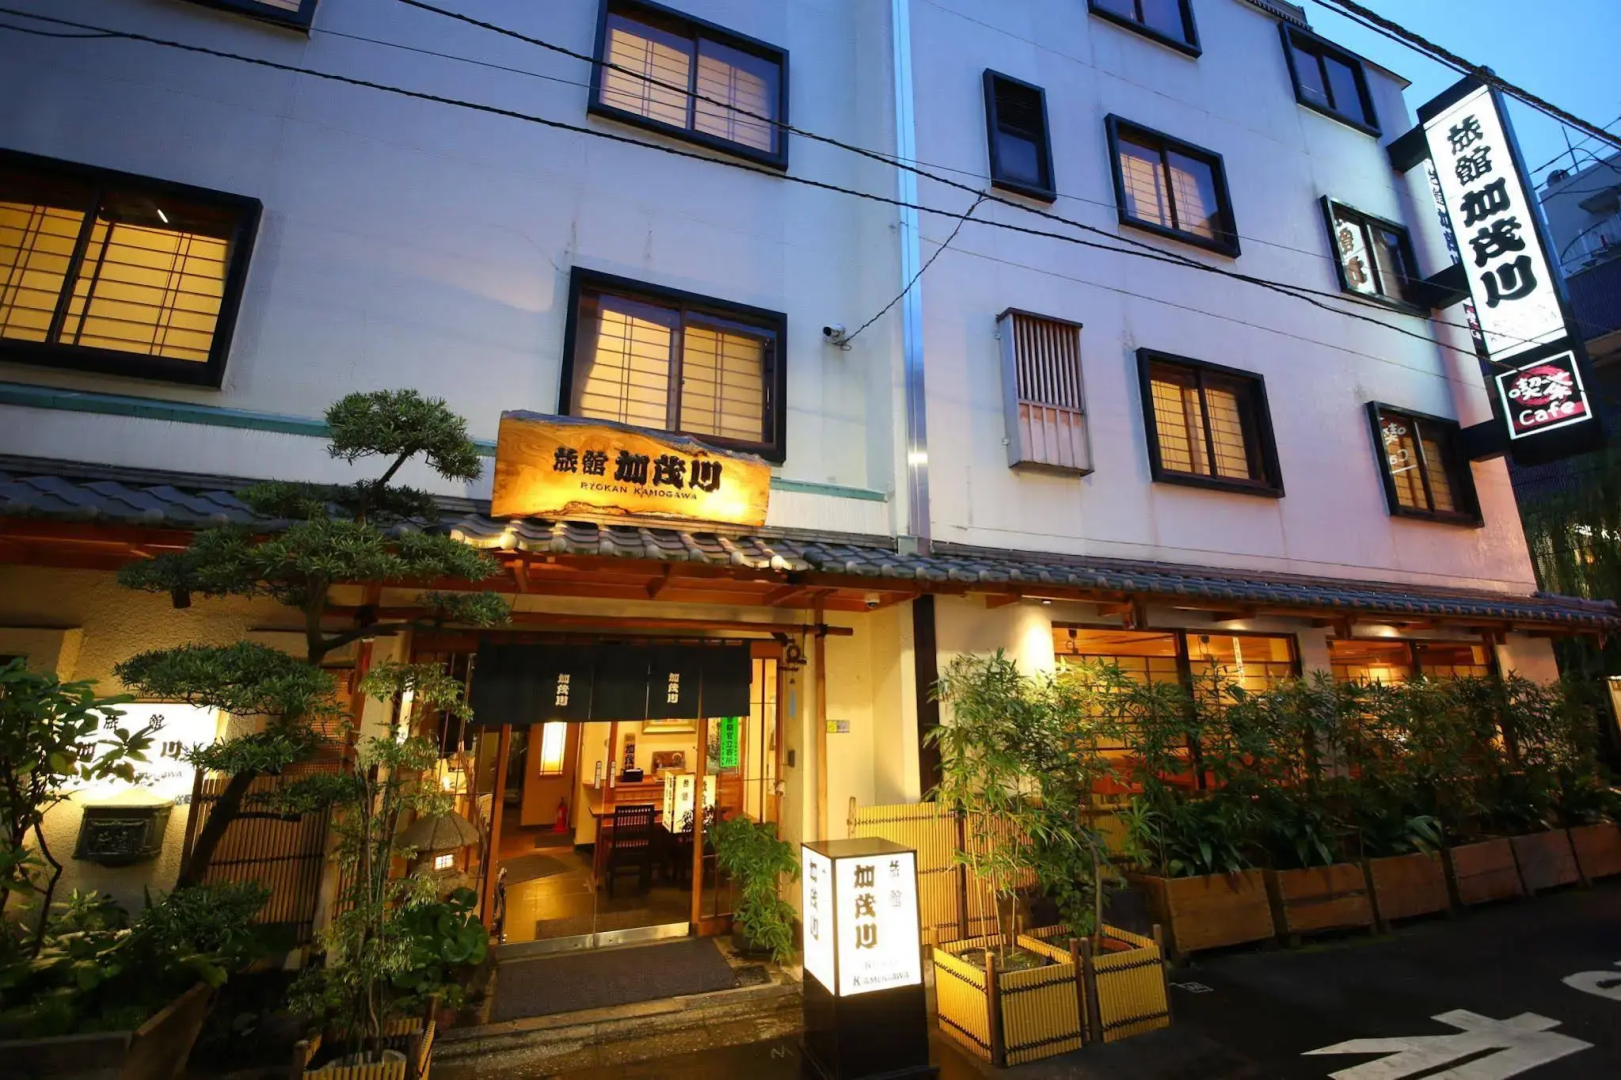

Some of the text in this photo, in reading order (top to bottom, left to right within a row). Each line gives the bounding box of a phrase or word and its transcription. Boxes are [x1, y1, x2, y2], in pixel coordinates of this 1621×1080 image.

[1446, 113, 1538, 309] 旅館加茂川
[1508, 369, 1574, 402] 喫茶
[1518, 400, 1576, 427] Cafe
[580, 481, 698, 501] RYOKAN KAMOGAWA
[555, 673, 571, 706] 加茂川
[666, 672, 680, 704] 加茂川
[853, 864, 878, 950] 加茂川
